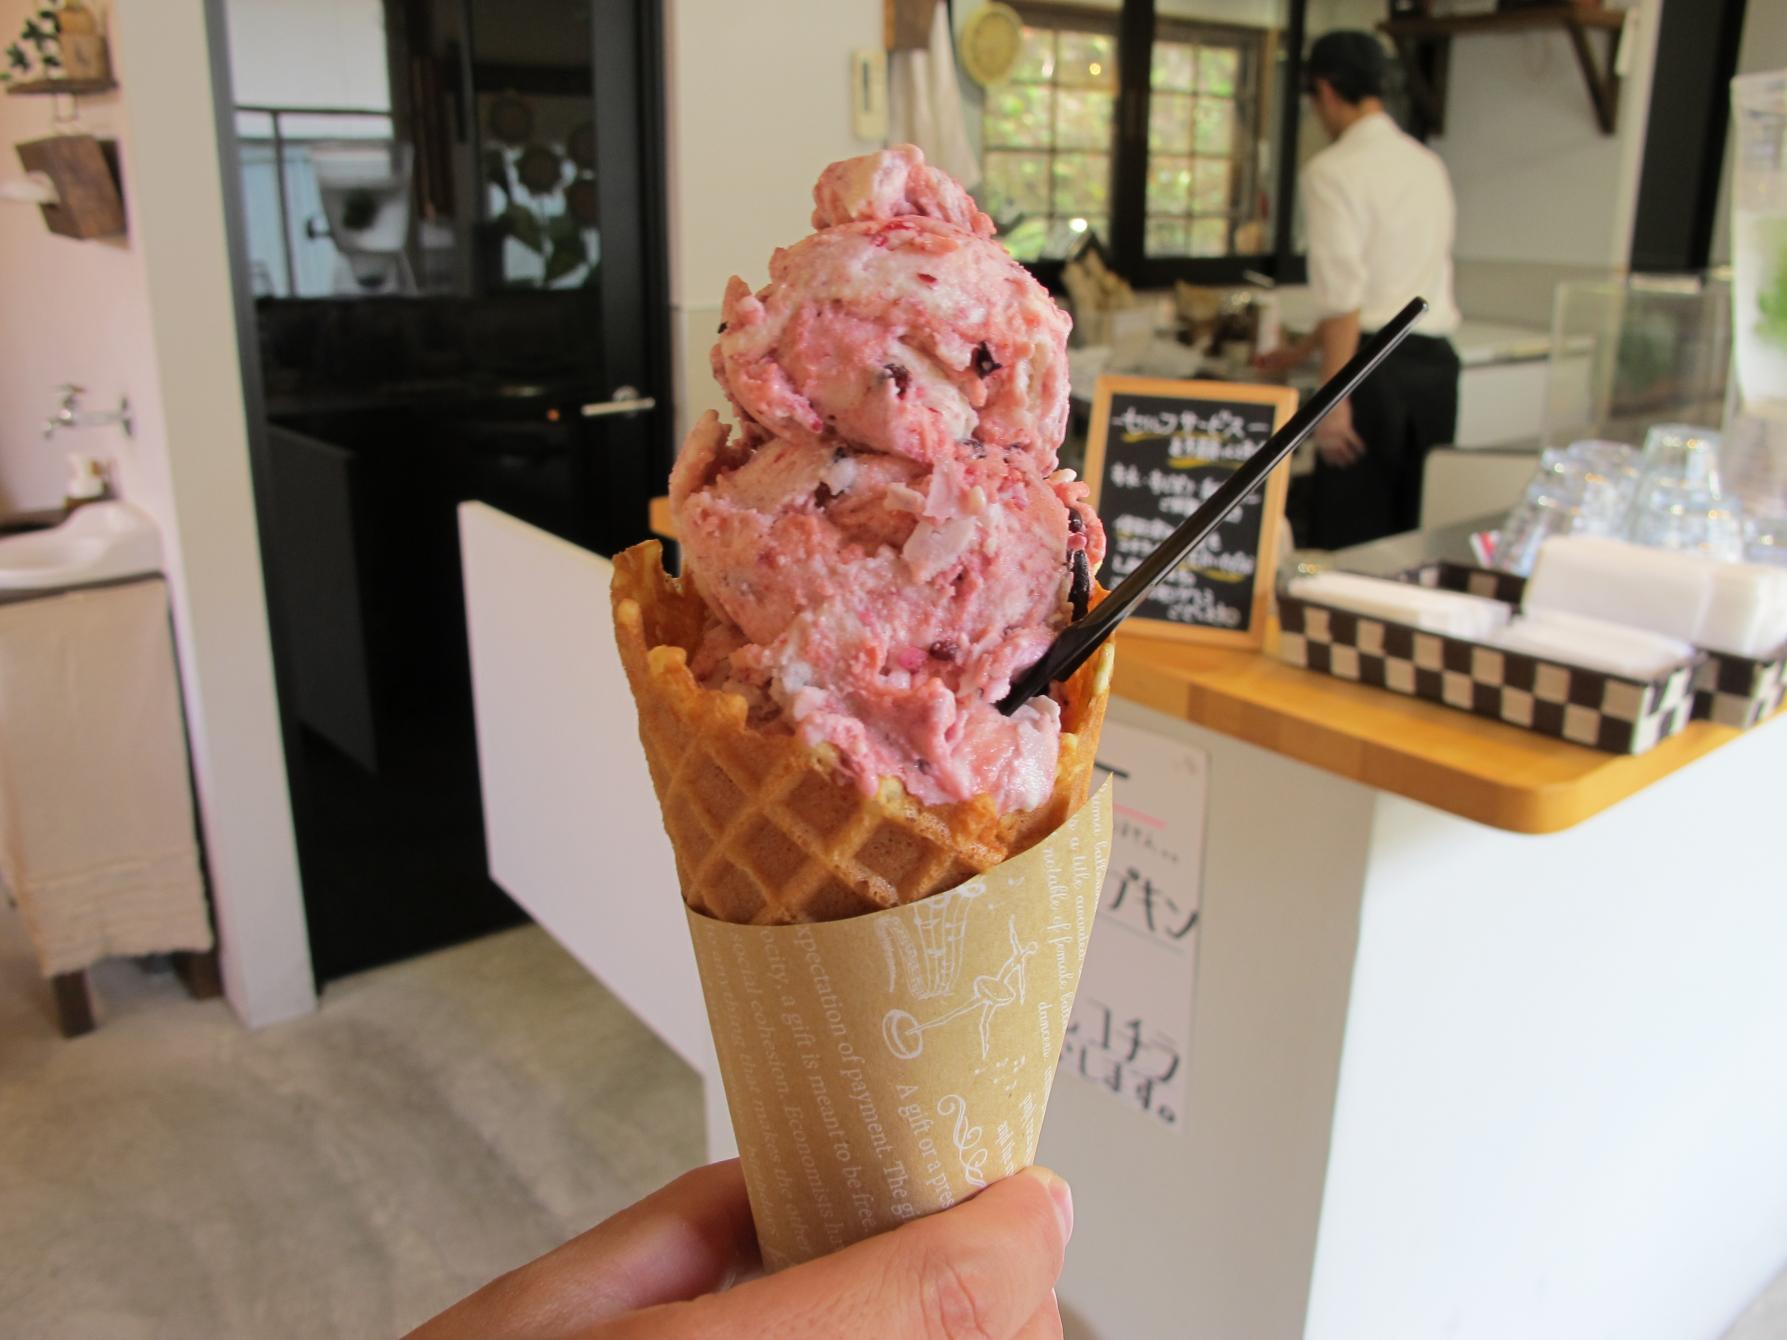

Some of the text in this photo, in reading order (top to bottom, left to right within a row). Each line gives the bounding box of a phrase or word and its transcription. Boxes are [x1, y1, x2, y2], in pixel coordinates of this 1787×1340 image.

[838, 1042, 865, 1063] of
[759, 927, 878, 1233] ocity, a gift is meant to be free.
[895, 1085, 919, 1099] A
[751, 1000, 790, 1100] cohesion.
[784, 1105, 834, 1218] Economists
[840, 1068, 894, 1159] payment.
[898, 1104, 934, 1136] gift
[918, 1139, 938, 1158] or
[883, 1161, 909, 1199] The
[927, 1161, 941, 1173] a
